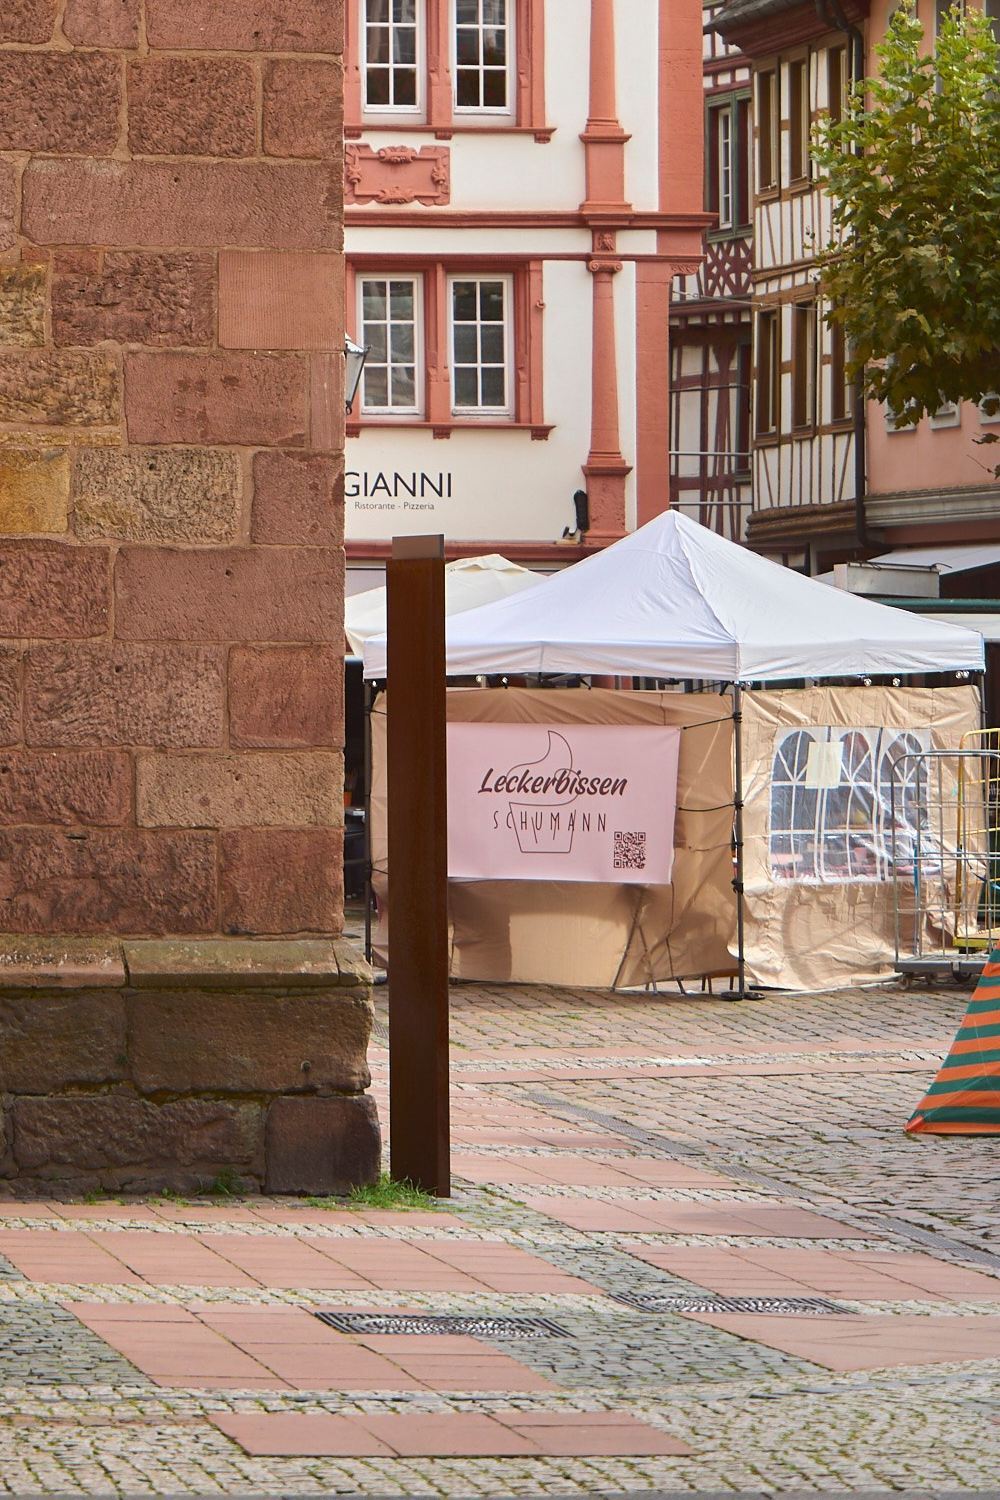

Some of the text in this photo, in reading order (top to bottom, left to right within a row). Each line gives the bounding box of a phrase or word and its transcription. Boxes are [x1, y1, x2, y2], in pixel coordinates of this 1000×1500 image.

[345, 471, 452, 498] GIANNI
[354, 501, 396, 510] Ristorante
[403, 501, 435, 510] Pizzeria
[477, 767, 628, 796] Leckerbissen
[493, 810, 606, 832] SCHUMANN
